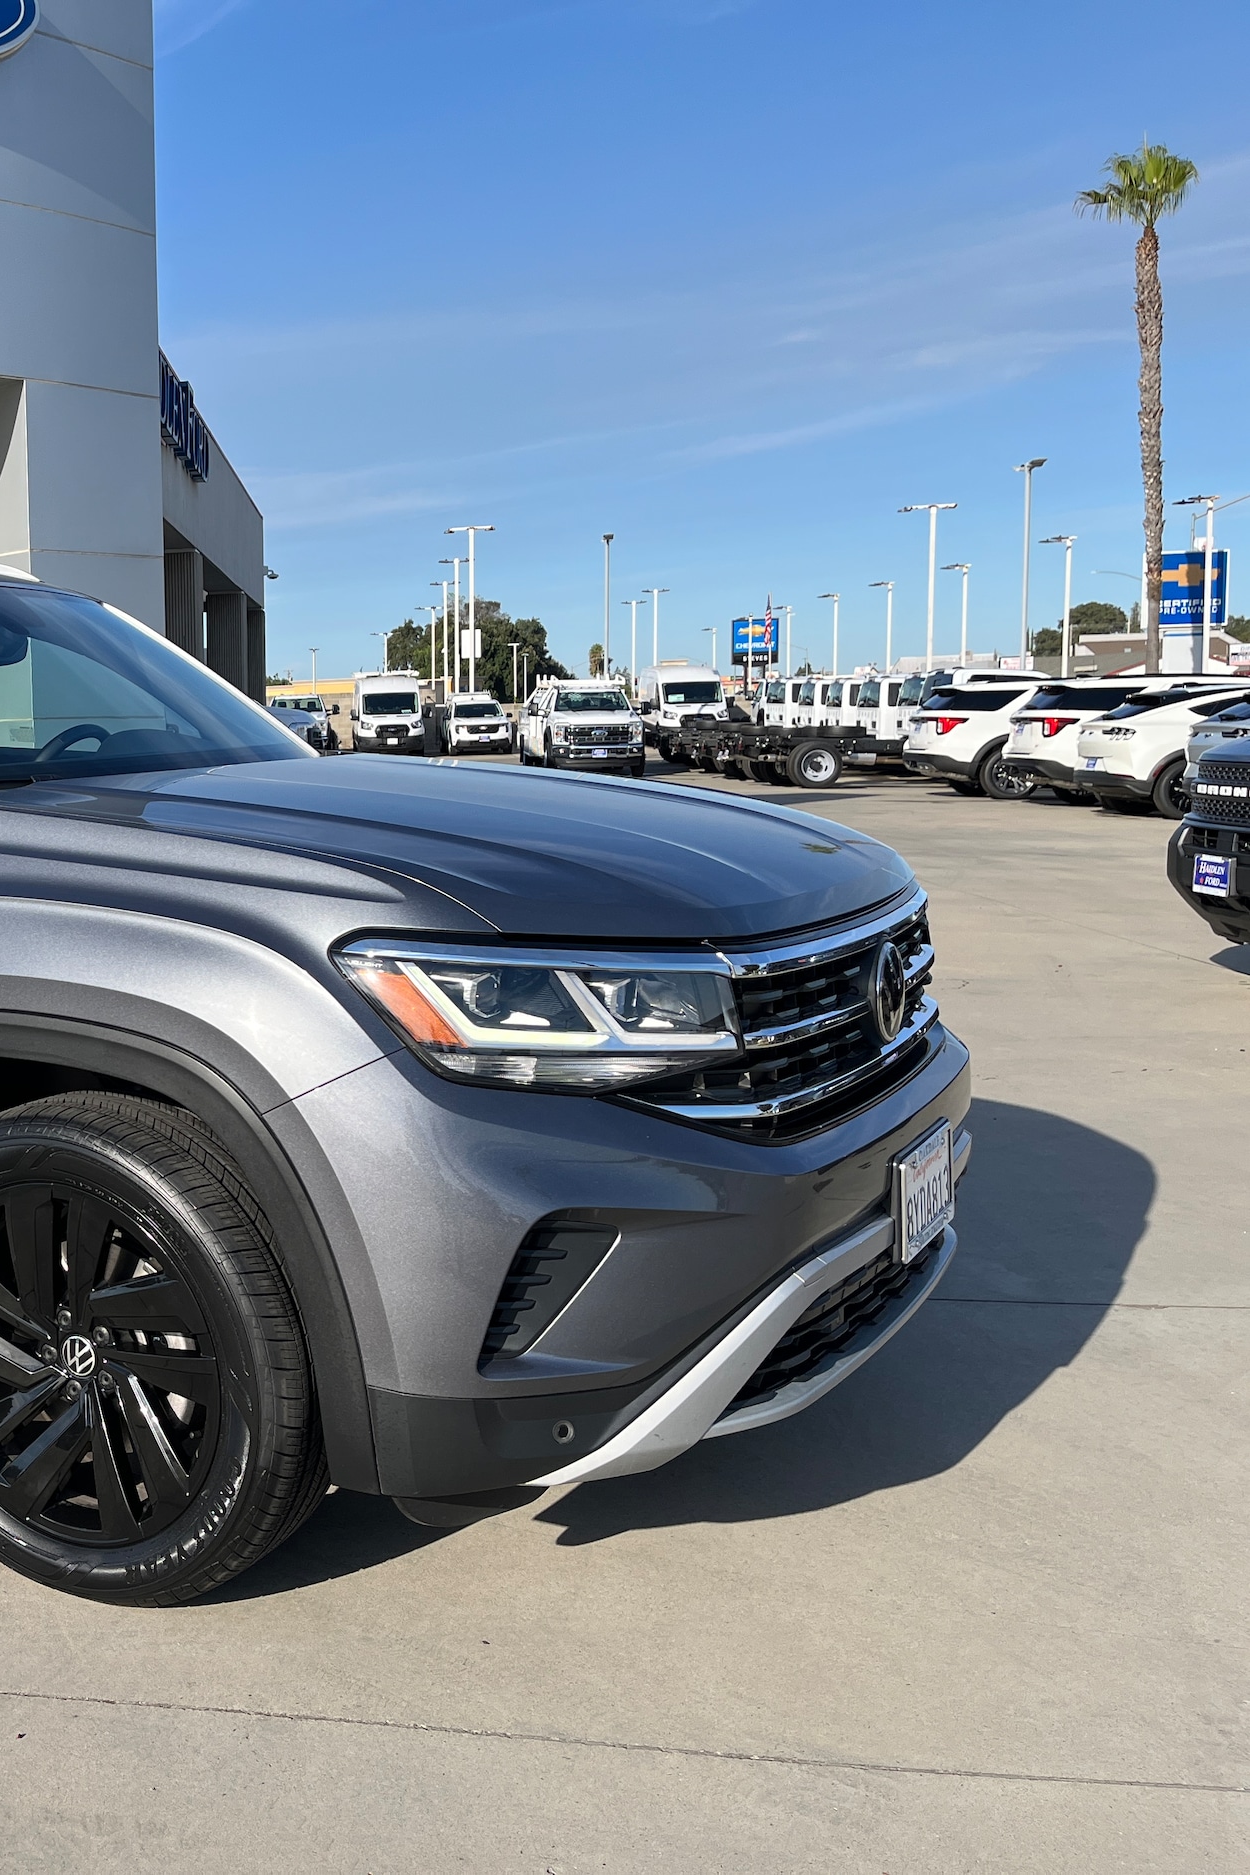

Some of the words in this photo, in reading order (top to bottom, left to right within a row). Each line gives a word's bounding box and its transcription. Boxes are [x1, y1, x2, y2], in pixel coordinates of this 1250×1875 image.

[1159, 598, 1221, 607] ERTIFID
[1159, 606, 1217, 615] RE-OWND
[1197, 783, 1250, 798] BRON
[907, 1164, 950, 1242] 8YDA813
